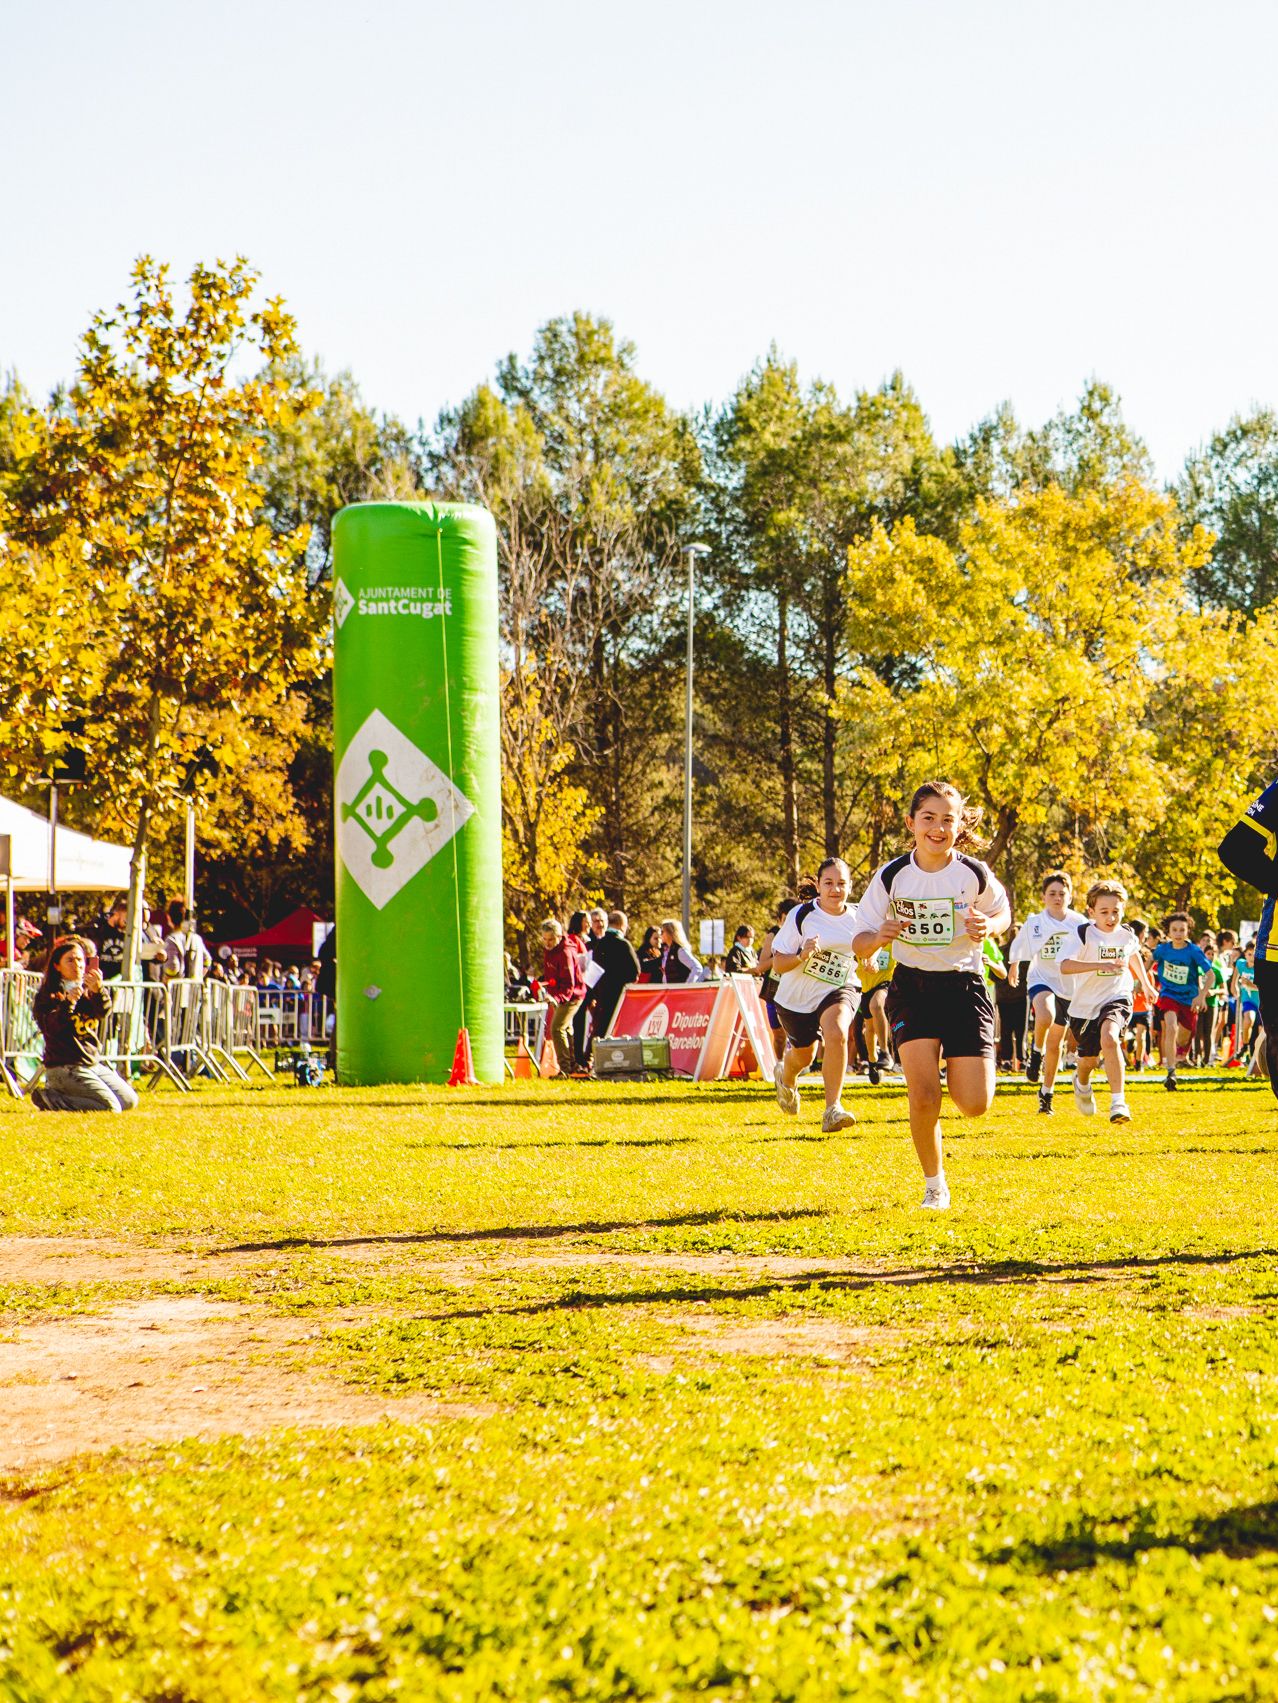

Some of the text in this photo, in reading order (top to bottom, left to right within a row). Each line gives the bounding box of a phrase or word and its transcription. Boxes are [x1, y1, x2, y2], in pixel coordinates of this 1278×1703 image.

[359, 587, 453, 600] AJUNTAMENT DE
[358, 599, 453, 619] SantCugat
[896, 906, 914, 916] CROS
[901, 921, 944, 935] 650
[811, 962, 841, 978] 2656
